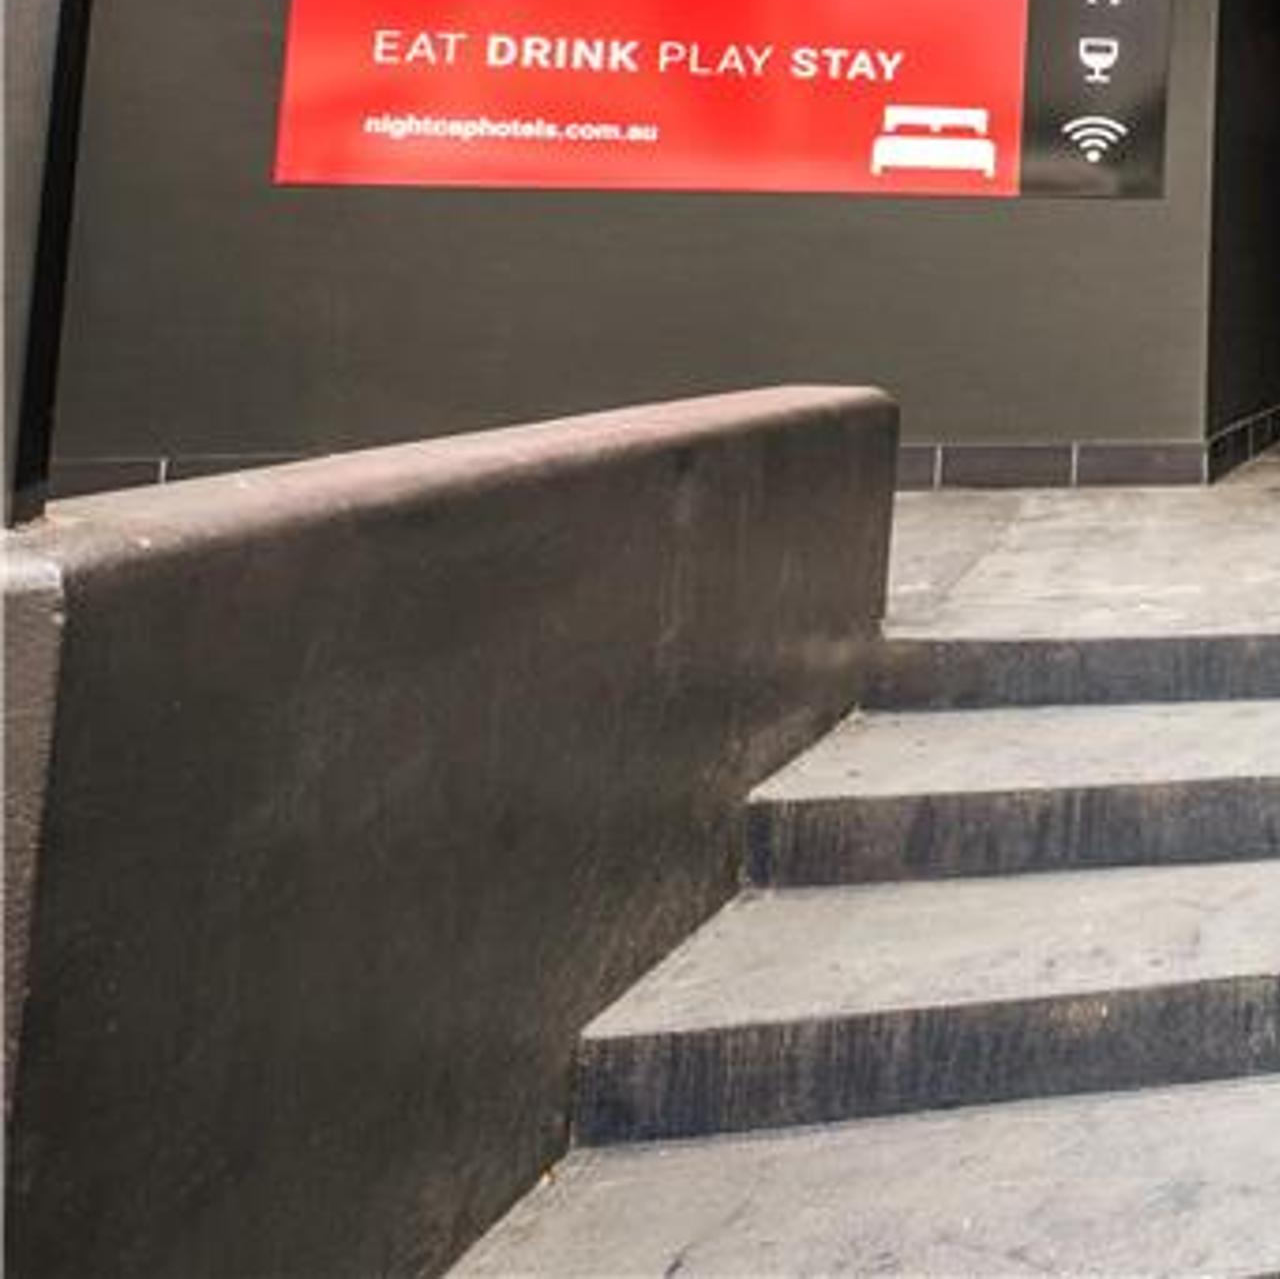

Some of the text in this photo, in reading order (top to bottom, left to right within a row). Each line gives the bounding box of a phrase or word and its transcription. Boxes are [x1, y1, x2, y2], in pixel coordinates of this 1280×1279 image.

[371, 29, 905, 82] EAT DRINK PLAY STAY
[364, 113, 659, 143] nightcaphotels.com.au
